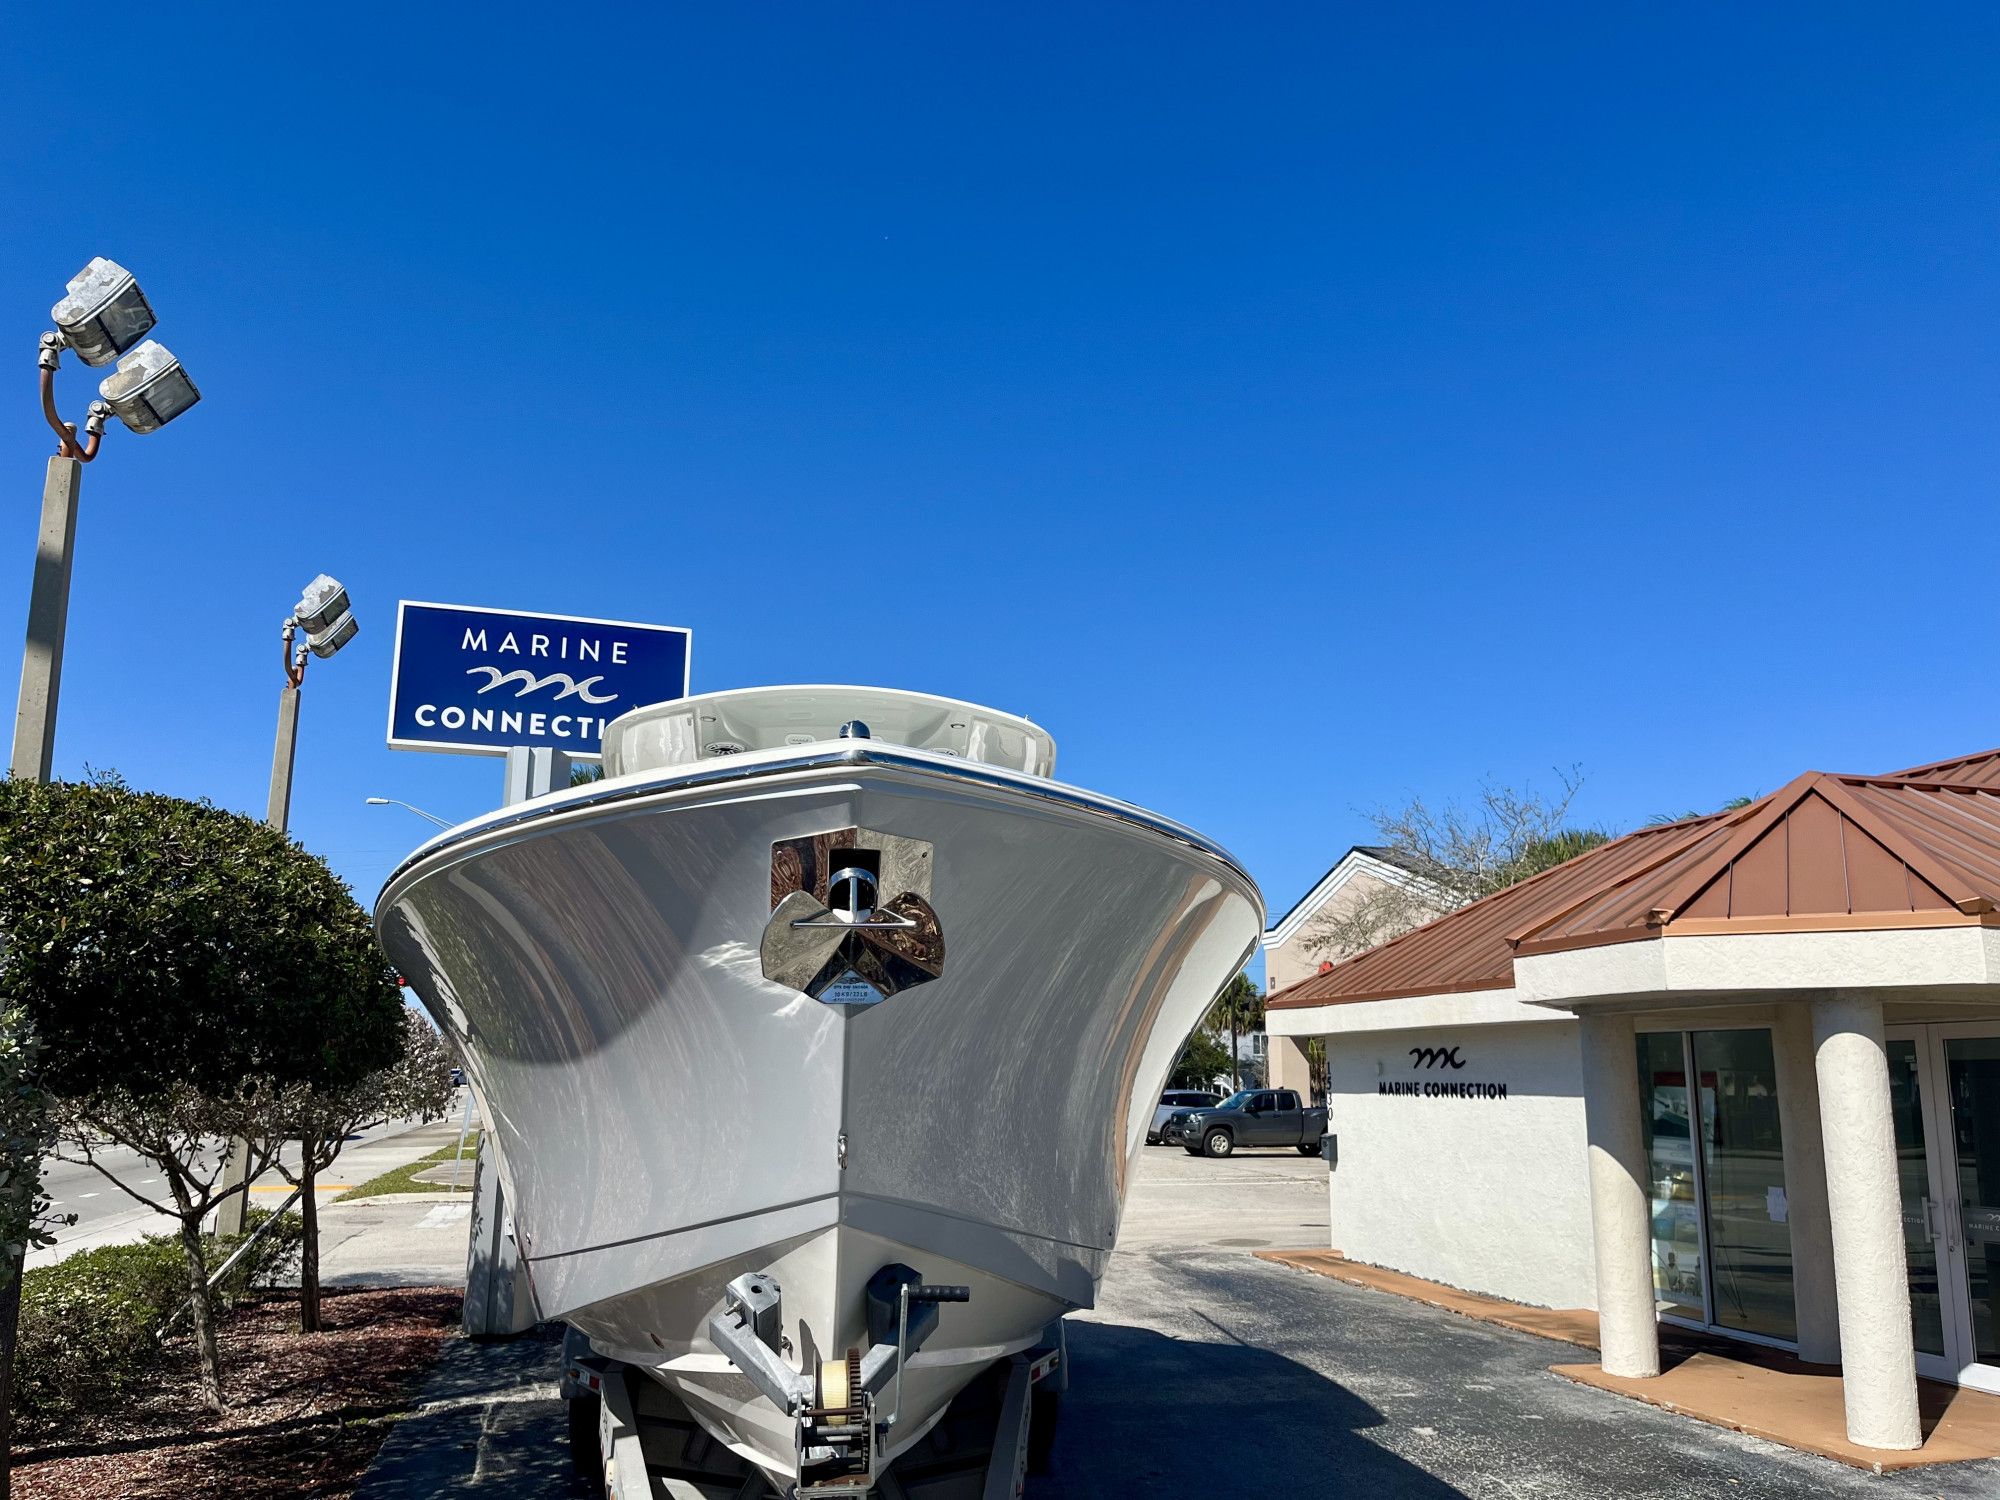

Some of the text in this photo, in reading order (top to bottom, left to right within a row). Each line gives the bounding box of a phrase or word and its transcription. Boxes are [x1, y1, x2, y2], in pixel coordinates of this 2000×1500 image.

[461, 628, 629, 665] MARINE
[1378, 1081, 1507, 1100] MARINE CONNECTION
[1968, 1223, 1993, 1232] MARINE
